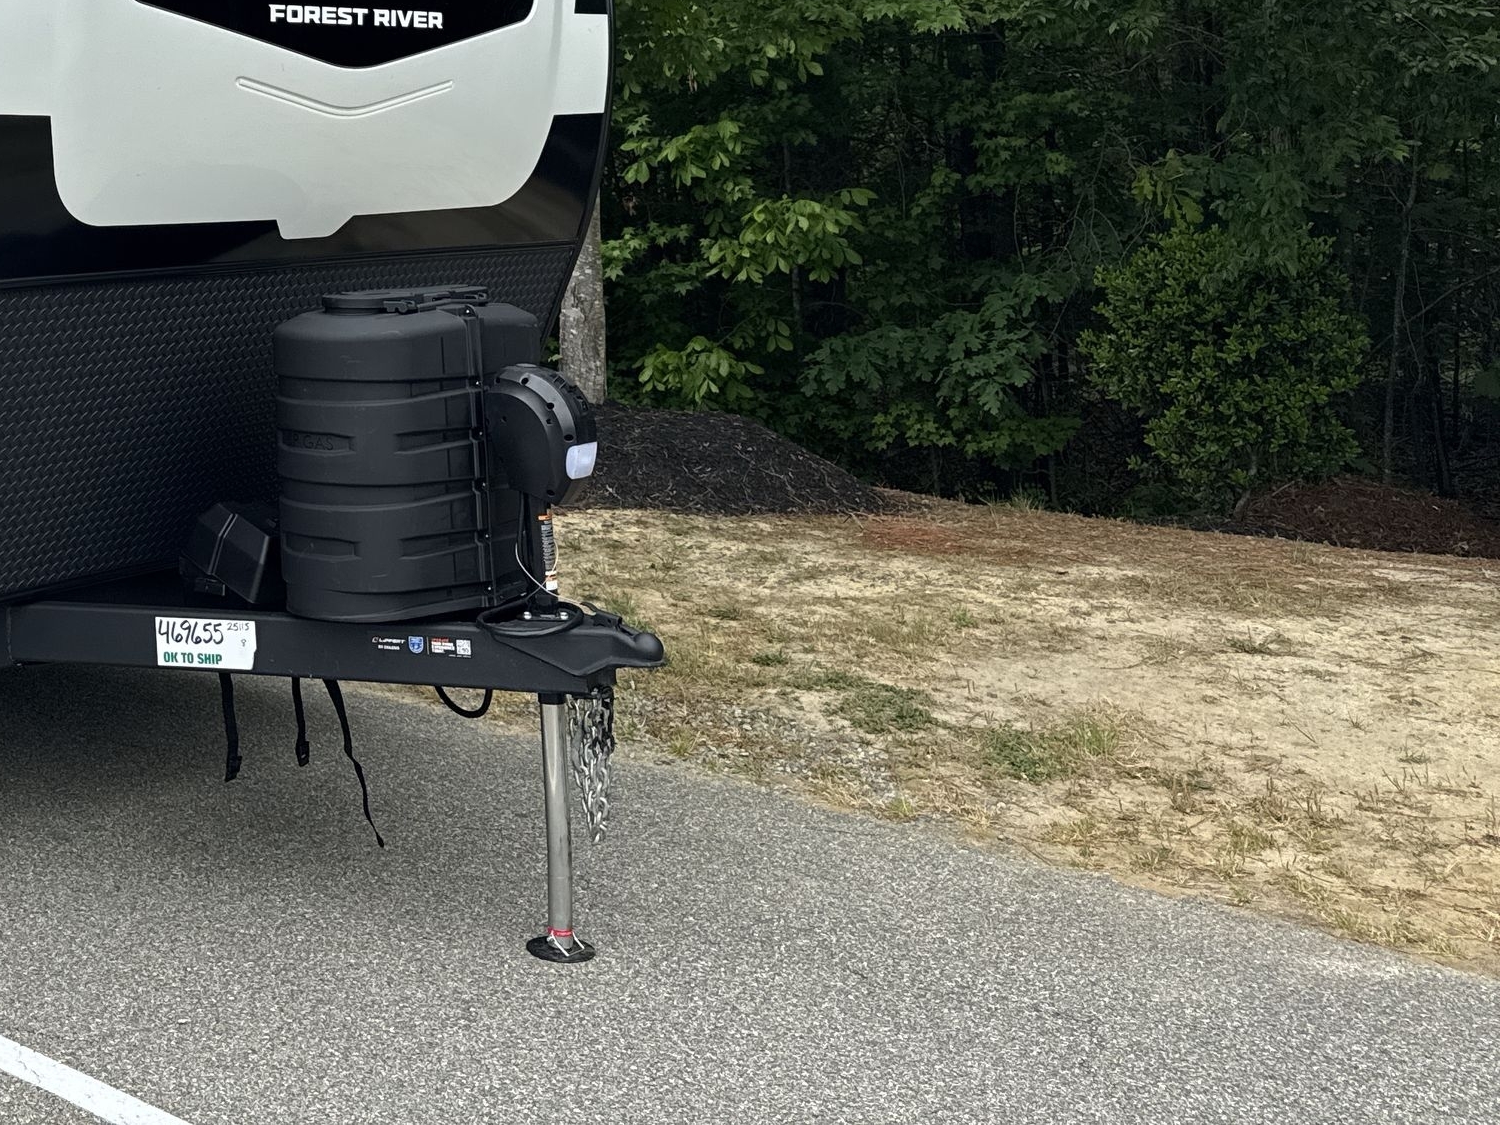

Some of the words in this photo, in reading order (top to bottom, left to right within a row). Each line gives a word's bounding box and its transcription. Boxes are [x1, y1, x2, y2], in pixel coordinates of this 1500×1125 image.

[268, 3, 369, 26] FOREST
[373, 8, 444, 29] RIVER
[303, 434, 334, 451] GAS
[157, 618, 224, 645] 469655
[163, 651, 179, 663] OK
[180, 652, 194, 664] TO
[197, 653, 223, 665] SHIP
